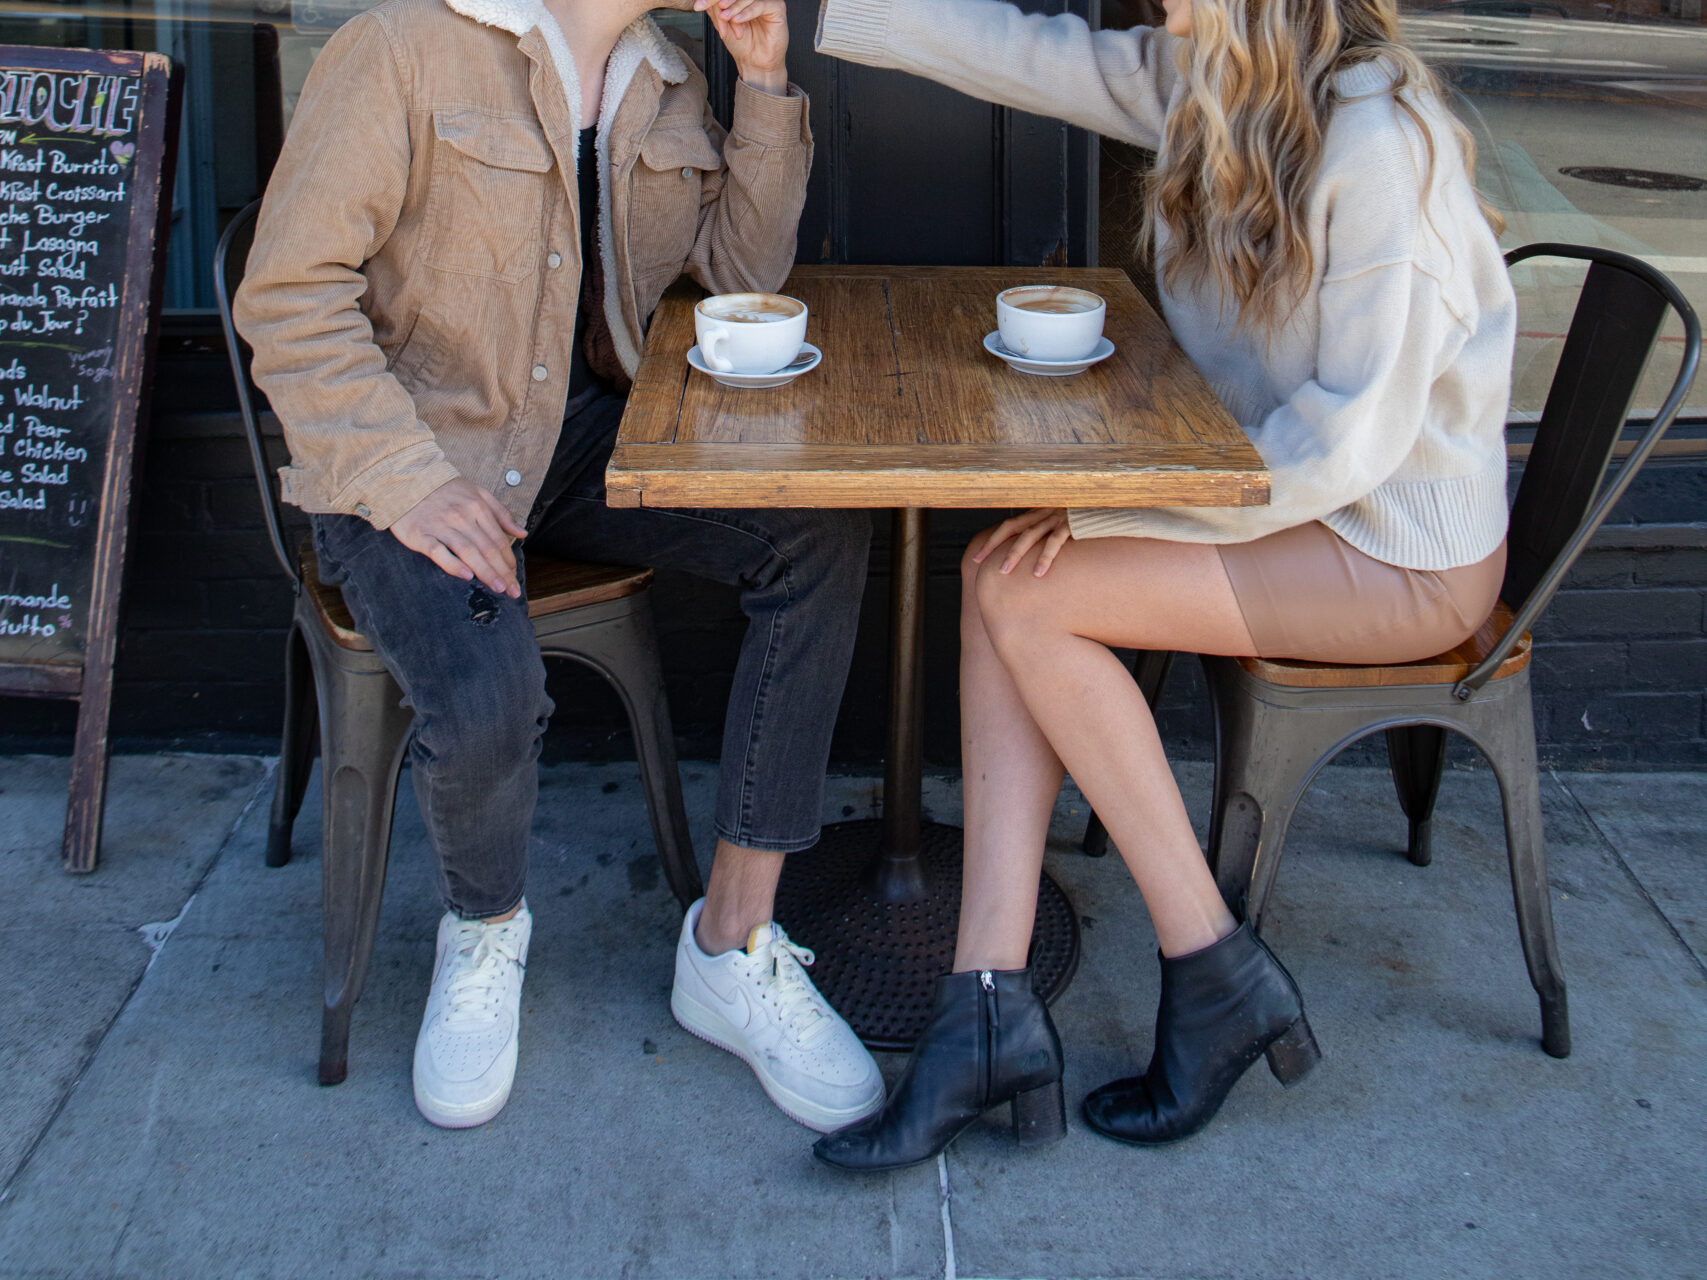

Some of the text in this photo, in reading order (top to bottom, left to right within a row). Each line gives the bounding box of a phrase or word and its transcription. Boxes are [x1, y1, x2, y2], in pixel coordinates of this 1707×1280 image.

[49, 148, 119, 175] Burrito
[46, 181, 126, 203] Croissant
[34, 204, 110, 236] Burger
[22, 230, 98, 269] Lasagna
[37, 255, 85, 280] Salad
[51, 283, 118, 309] Parfait
[10, 310, 33, 331] du
[14, 384, 84, 410] Walnut
[24, 416, 72, 438] Pear
[13, 439, 87, 463] Chicken
[21, 463, 69, 485] Salad
[0, 488, 46, 510] Salad
